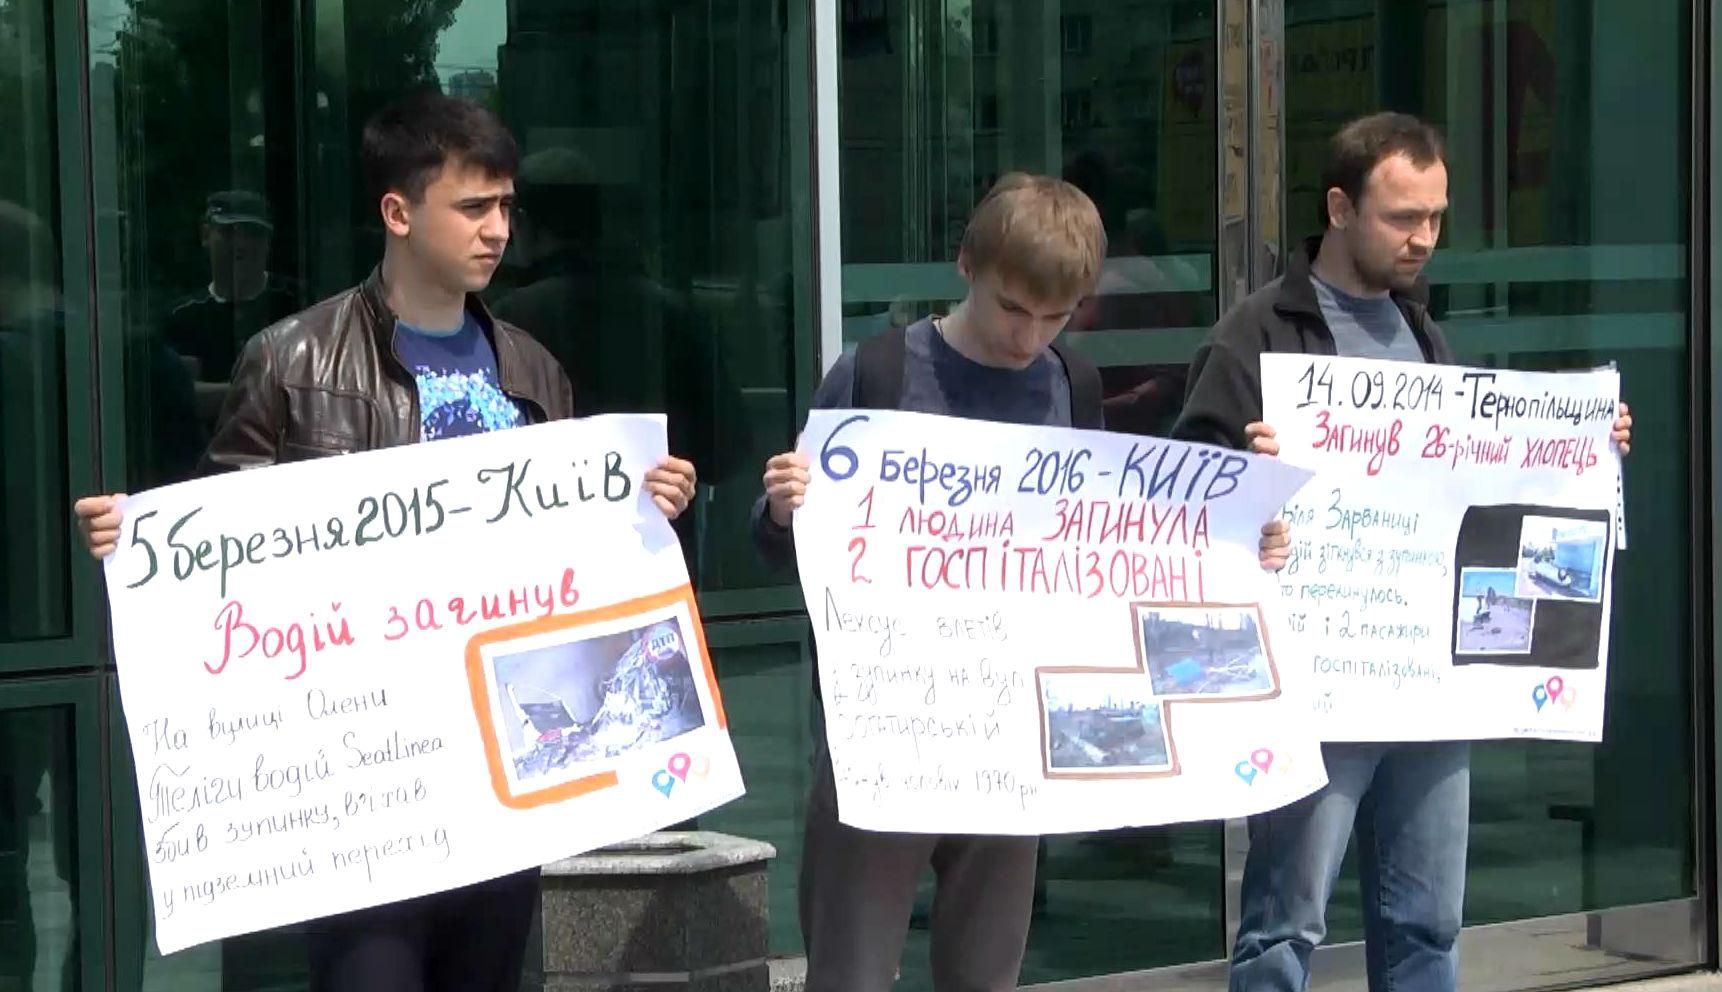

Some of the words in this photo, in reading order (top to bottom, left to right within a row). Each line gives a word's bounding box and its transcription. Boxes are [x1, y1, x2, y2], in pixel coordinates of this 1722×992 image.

[819, 415, 871, 482] 6
[879, 448, 1001, 506] Березня
[1018, 448, 1092, 497] 2016
[1119, 442, 1252, 501] КИЇВ
[851, 485, 876, 530] 1
[899, 506, 1015, 540] ЛЮДИНА
[1042, 499, 1211, 549] ЗАГИНУЛА
[127, 510, 158, 589] 5
[167, 506, 351, 598] березня
[847, 536, 873, 584] 2
[905, 541, 1204, 602] ГОСПІТАЛІЗОВАНІ
[203, 600, 357, 681] Водій
[383, 567, 581, 642] загинув
[1339, 610, 1355, 639] 2
[143, 717, 188, 754] На
[208, 707, 284, 745] вулиці
[307, 688, 388, 719] Олени
[254, 749, 335, 797] водій
[154, 821, 209, 865] збив
[183, 847, 315, 905] підземний
